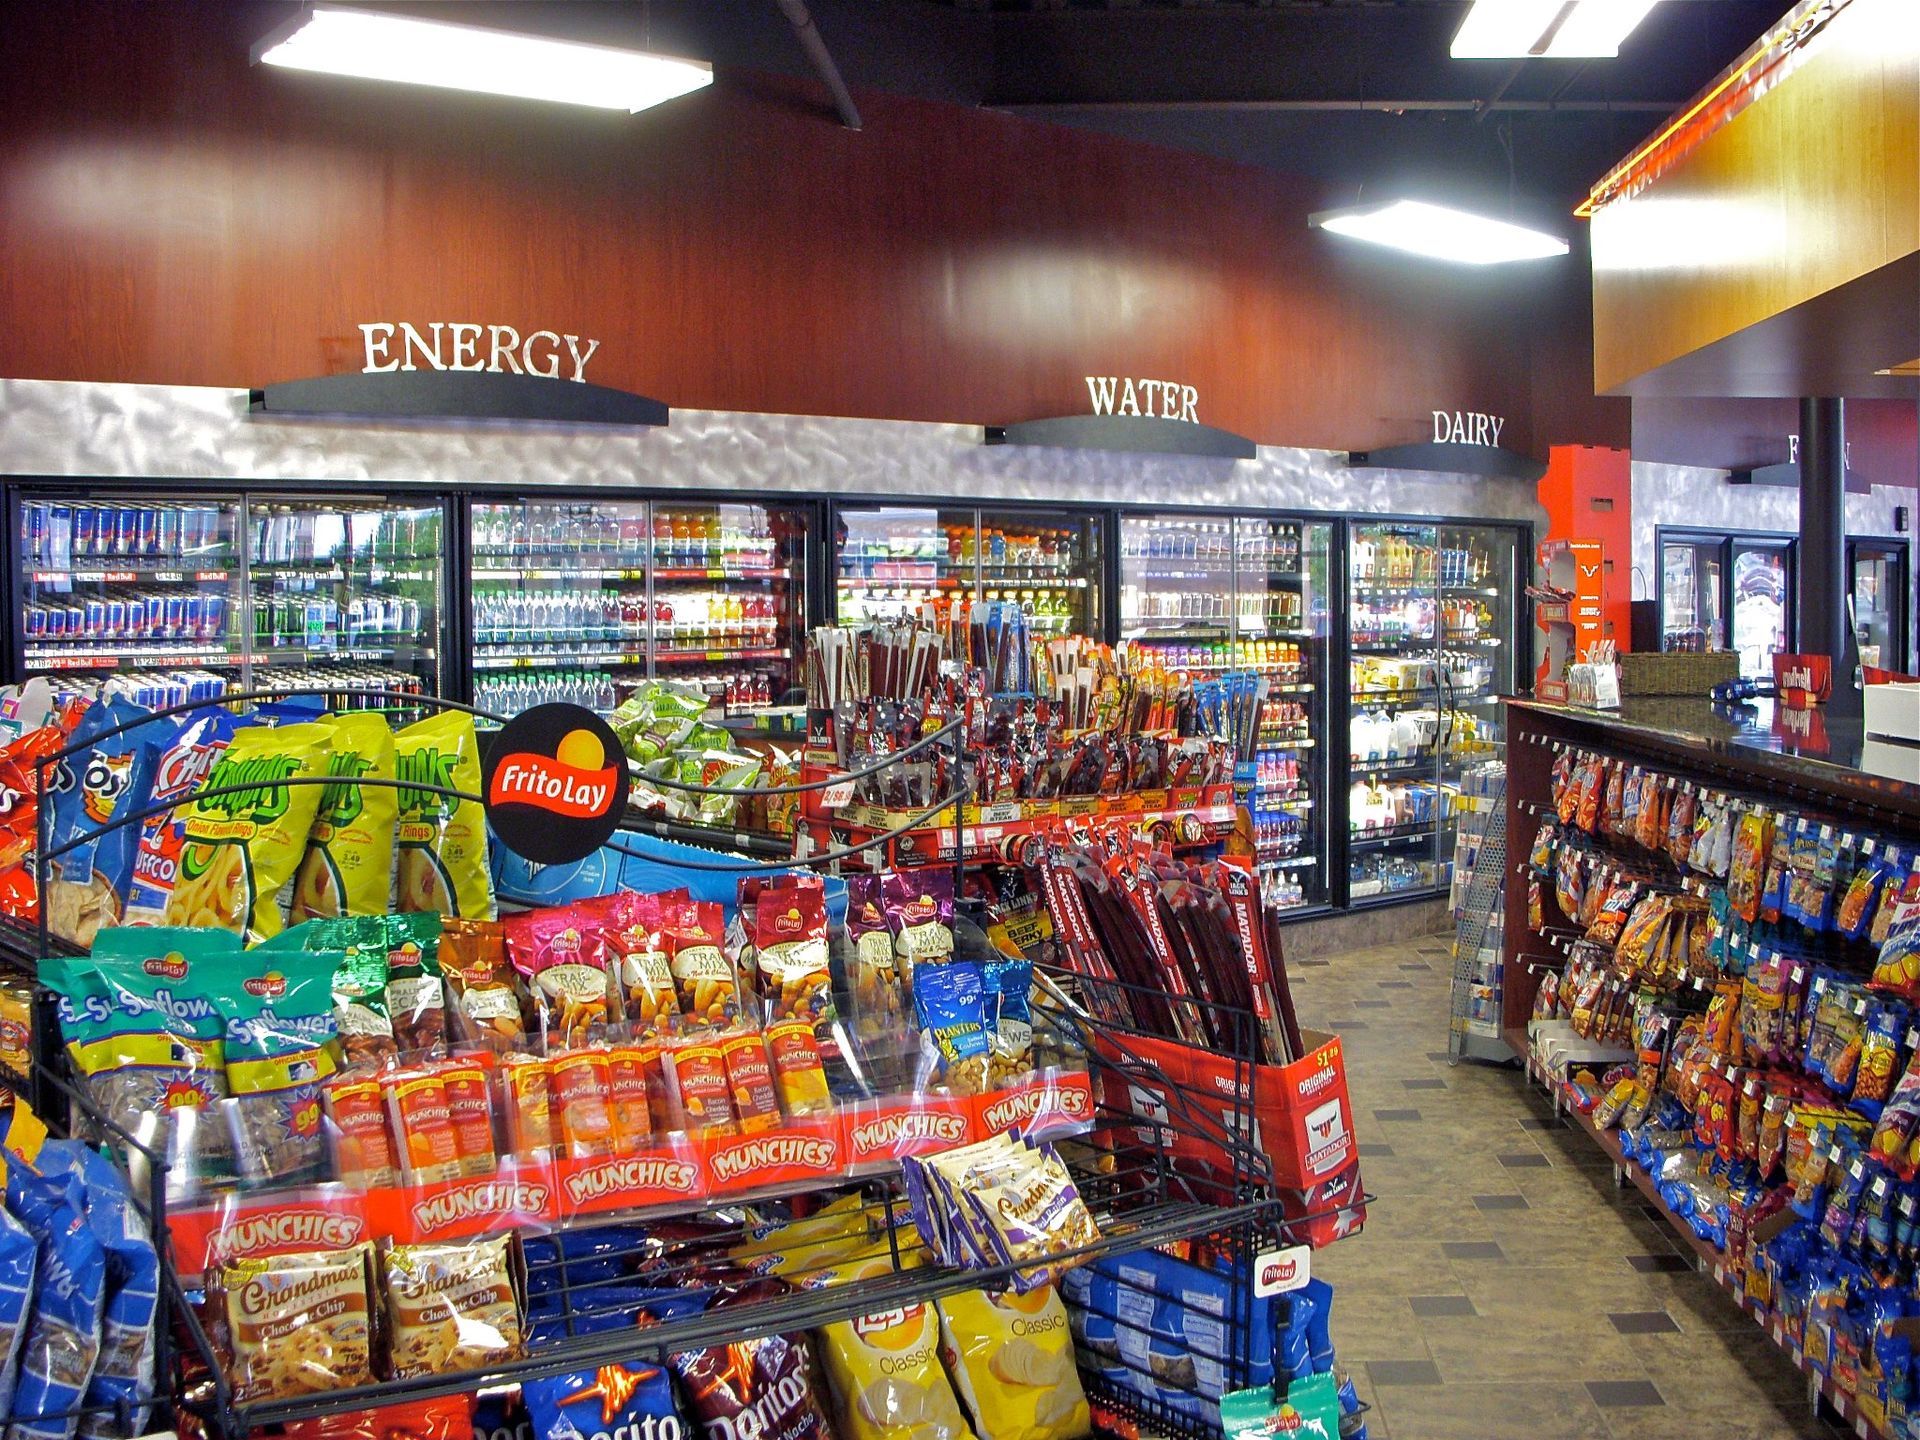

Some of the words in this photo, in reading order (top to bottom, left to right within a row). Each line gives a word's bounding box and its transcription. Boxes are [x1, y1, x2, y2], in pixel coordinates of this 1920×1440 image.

[358, 322, 600, 384] ENERGY
[1085, 376, 1200, 424] WATER
[1432, 411, 1505, 448] DAIRY
[403, 824, 430, 839] Rings
[1041, 864, 1067, 934] MATADOR
[1056, 873, 1084, 943] MATADOR
[1066, 874, 1095, 941] MATADOR
[1008, 921, 1038, 938] BEEF
[1014, 929, 1044, 946] ERKY
[1142, 887, 1168, 958] MATADOR
[1235, 902, 1258, 975] MATADOR
[700, 960, 725, 970] MIX
[934, 1021, 982, 1040] PLANTERS
[731, 1064, 769, 1080] MUNCHIES
[777, 1051, 817, 1064] MUNCHIES
[682, 1076, 727, 1089] MUNCHIES
[1299, 1065, 1336, 1094] ORIGINAL
[342, 1112, 385, 1125] MUNCHIES
[406, 1108, 451, 1124] MUNCHIES
[986, 1091, 1087, 1131] MUNCHIES
[854, 1115, 965, 1153] MUNCHIES
[714, 1140, 833, 1178] MUNCHIES
[1308, 1135, 1349, 1166] MATADOR
[568, 1162, 696, 1202] MUNCHIES
[417, 1183, 549, 1232] MUNCHIES
[209, 1215, 361, 1252] MUNCHIES
[316, 1299, 346, 1319] Chip
[468, 1291, 499, 1308] Chip
[1011, 1312, 1066, 1338] Classic
[879, 1344, 936, 1376] Classic
[784, 1412, 815, 1440] Nacho
